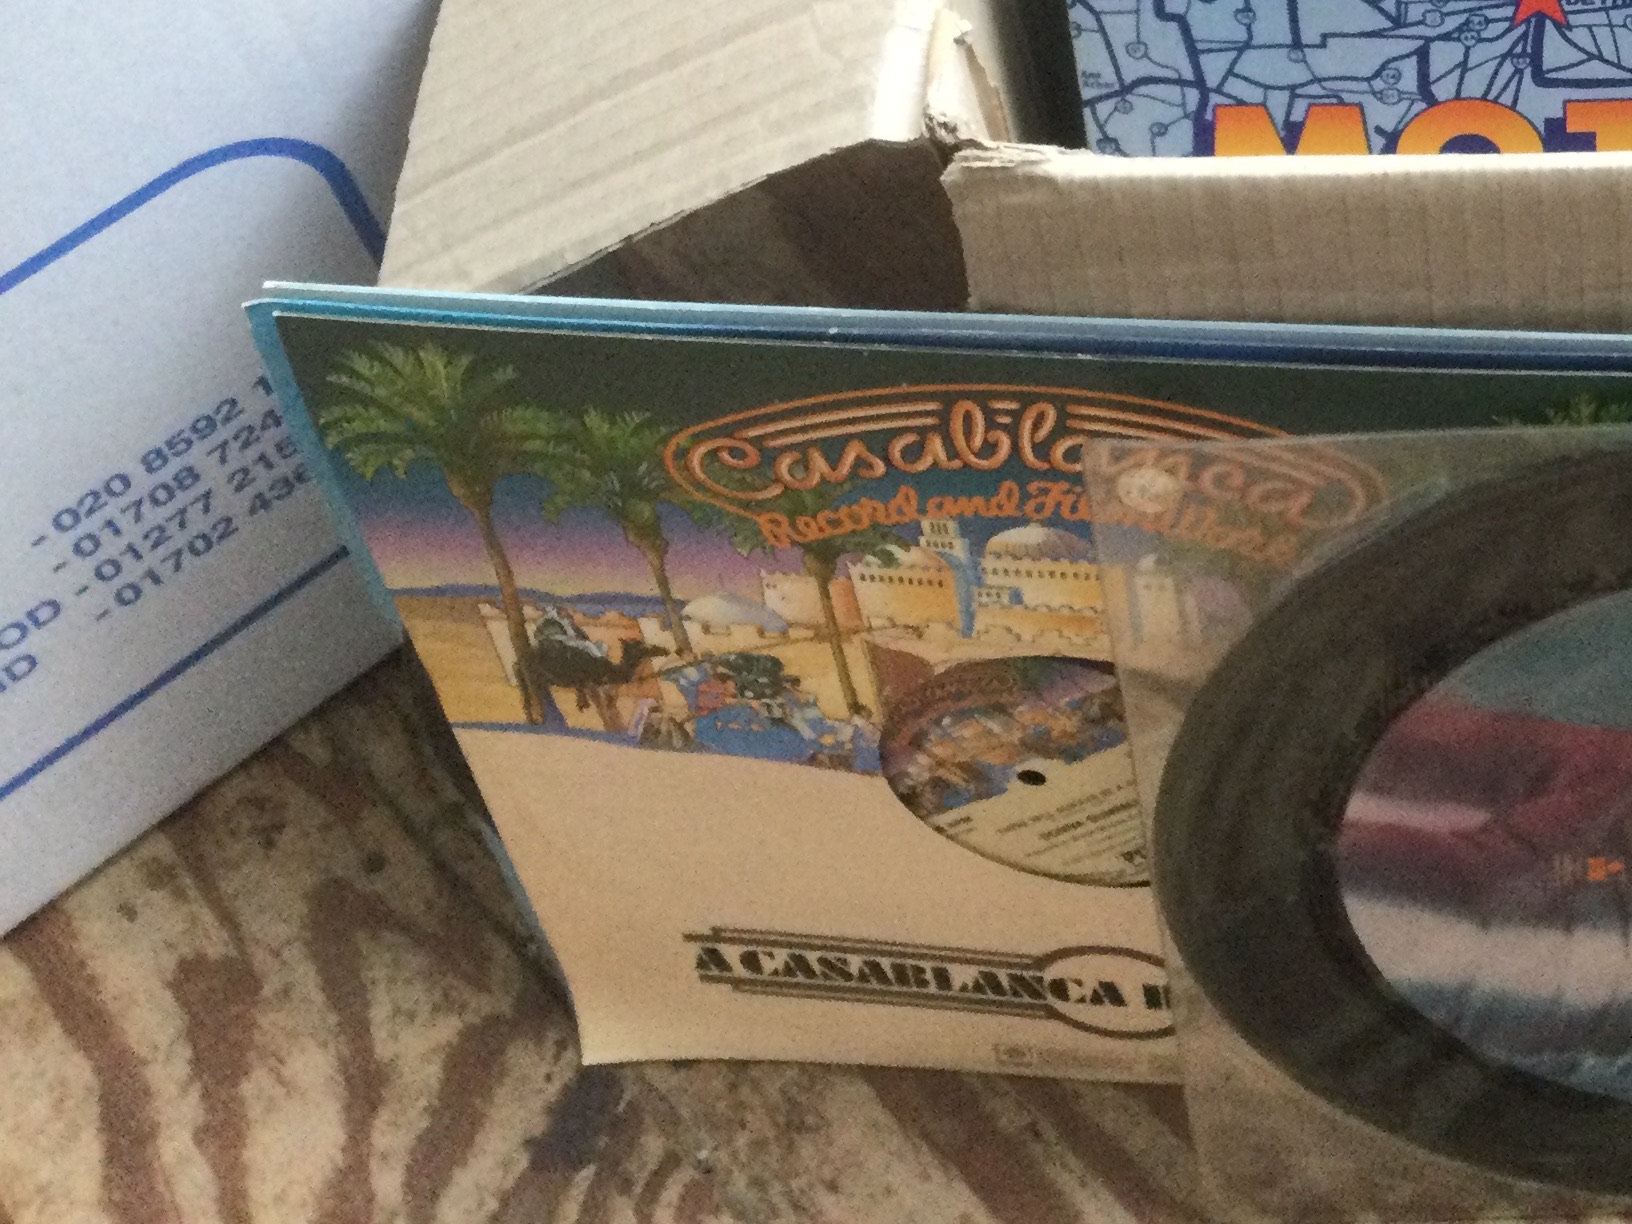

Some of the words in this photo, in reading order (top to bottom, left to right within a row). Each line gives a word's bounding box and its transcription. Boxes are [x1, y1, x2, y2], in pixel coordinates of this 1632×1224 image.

[140, 396, 244, 475] 8592
[757, 485, 921, 548] Record
[925, 479, 1024, 520] and
[739, 949, 1127, 1008] CASABLANCA
